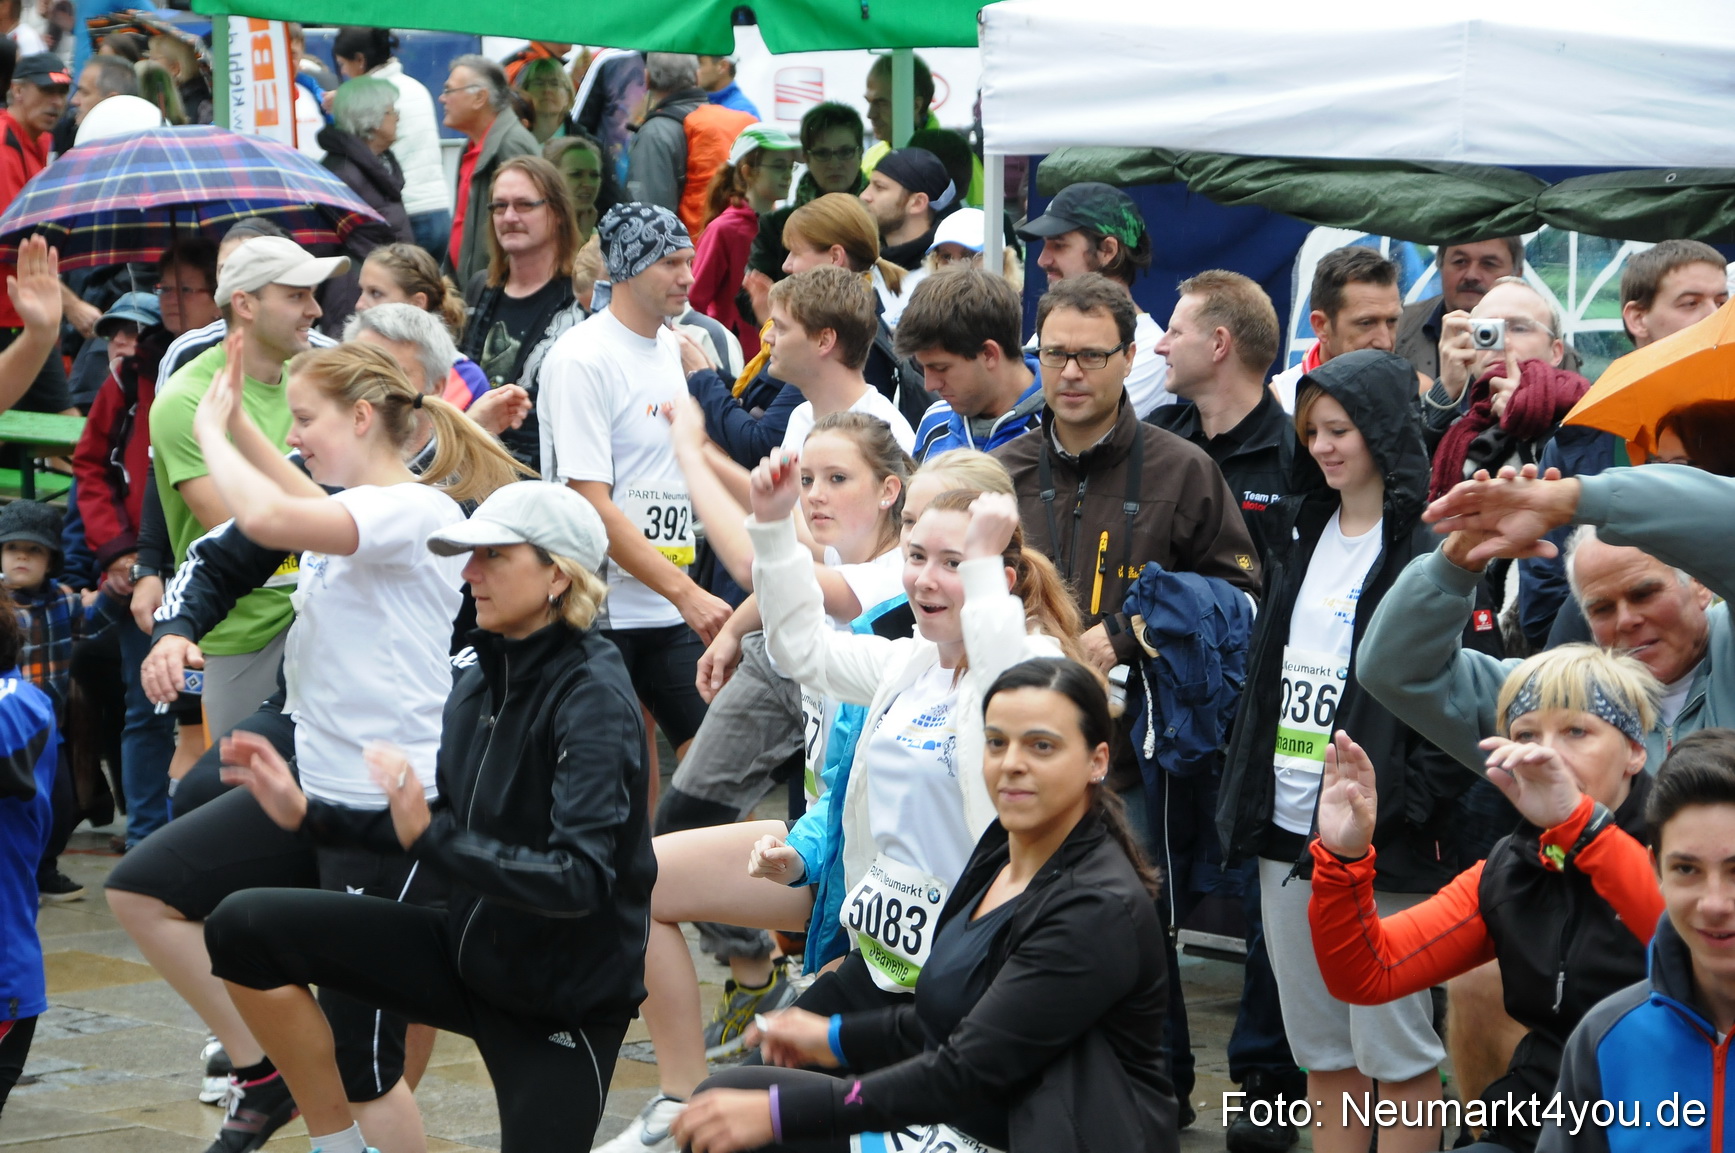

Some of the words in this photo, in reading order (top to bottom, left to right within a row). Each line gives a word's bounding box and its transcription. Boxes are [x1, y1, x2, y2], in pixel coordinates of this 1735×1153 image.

[628, 489, 661, 500] PARTL
[1243, 491, 1269, 503] Team
[1270, 494, 1280, 504] P
[644, 505, 688, 541] 392
[884, 873, 923, 898] Neumarkt
[848, 884, 928, 956] 5083
[868, 941, 909, 982] Jeanette
